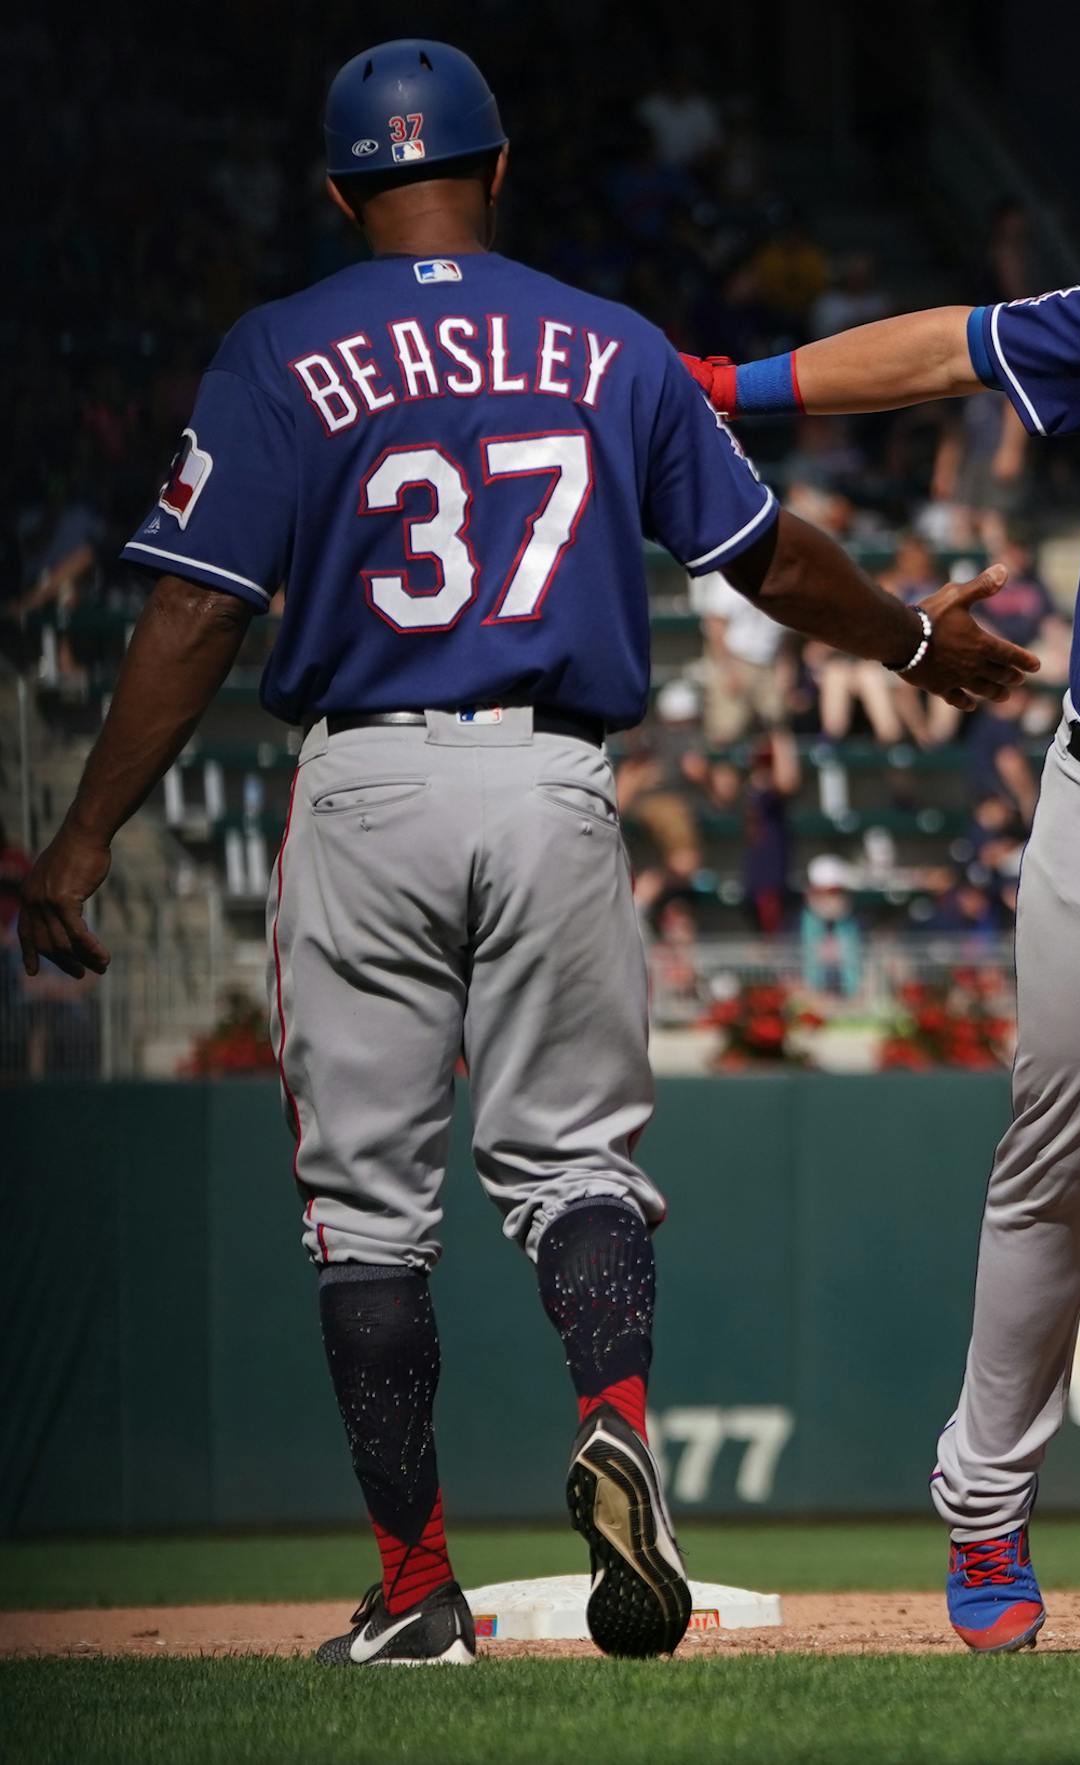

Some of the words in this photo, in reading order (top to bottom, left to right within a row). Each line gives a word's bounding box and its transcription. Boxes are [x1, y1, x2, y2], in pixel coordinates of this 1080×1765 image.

[389, 113, 424, 142] 37
[291, 314, 619, 437] BEASLEY
[358, 429, 594, 634] 37
[645, 1405, 796, 1503] 77
